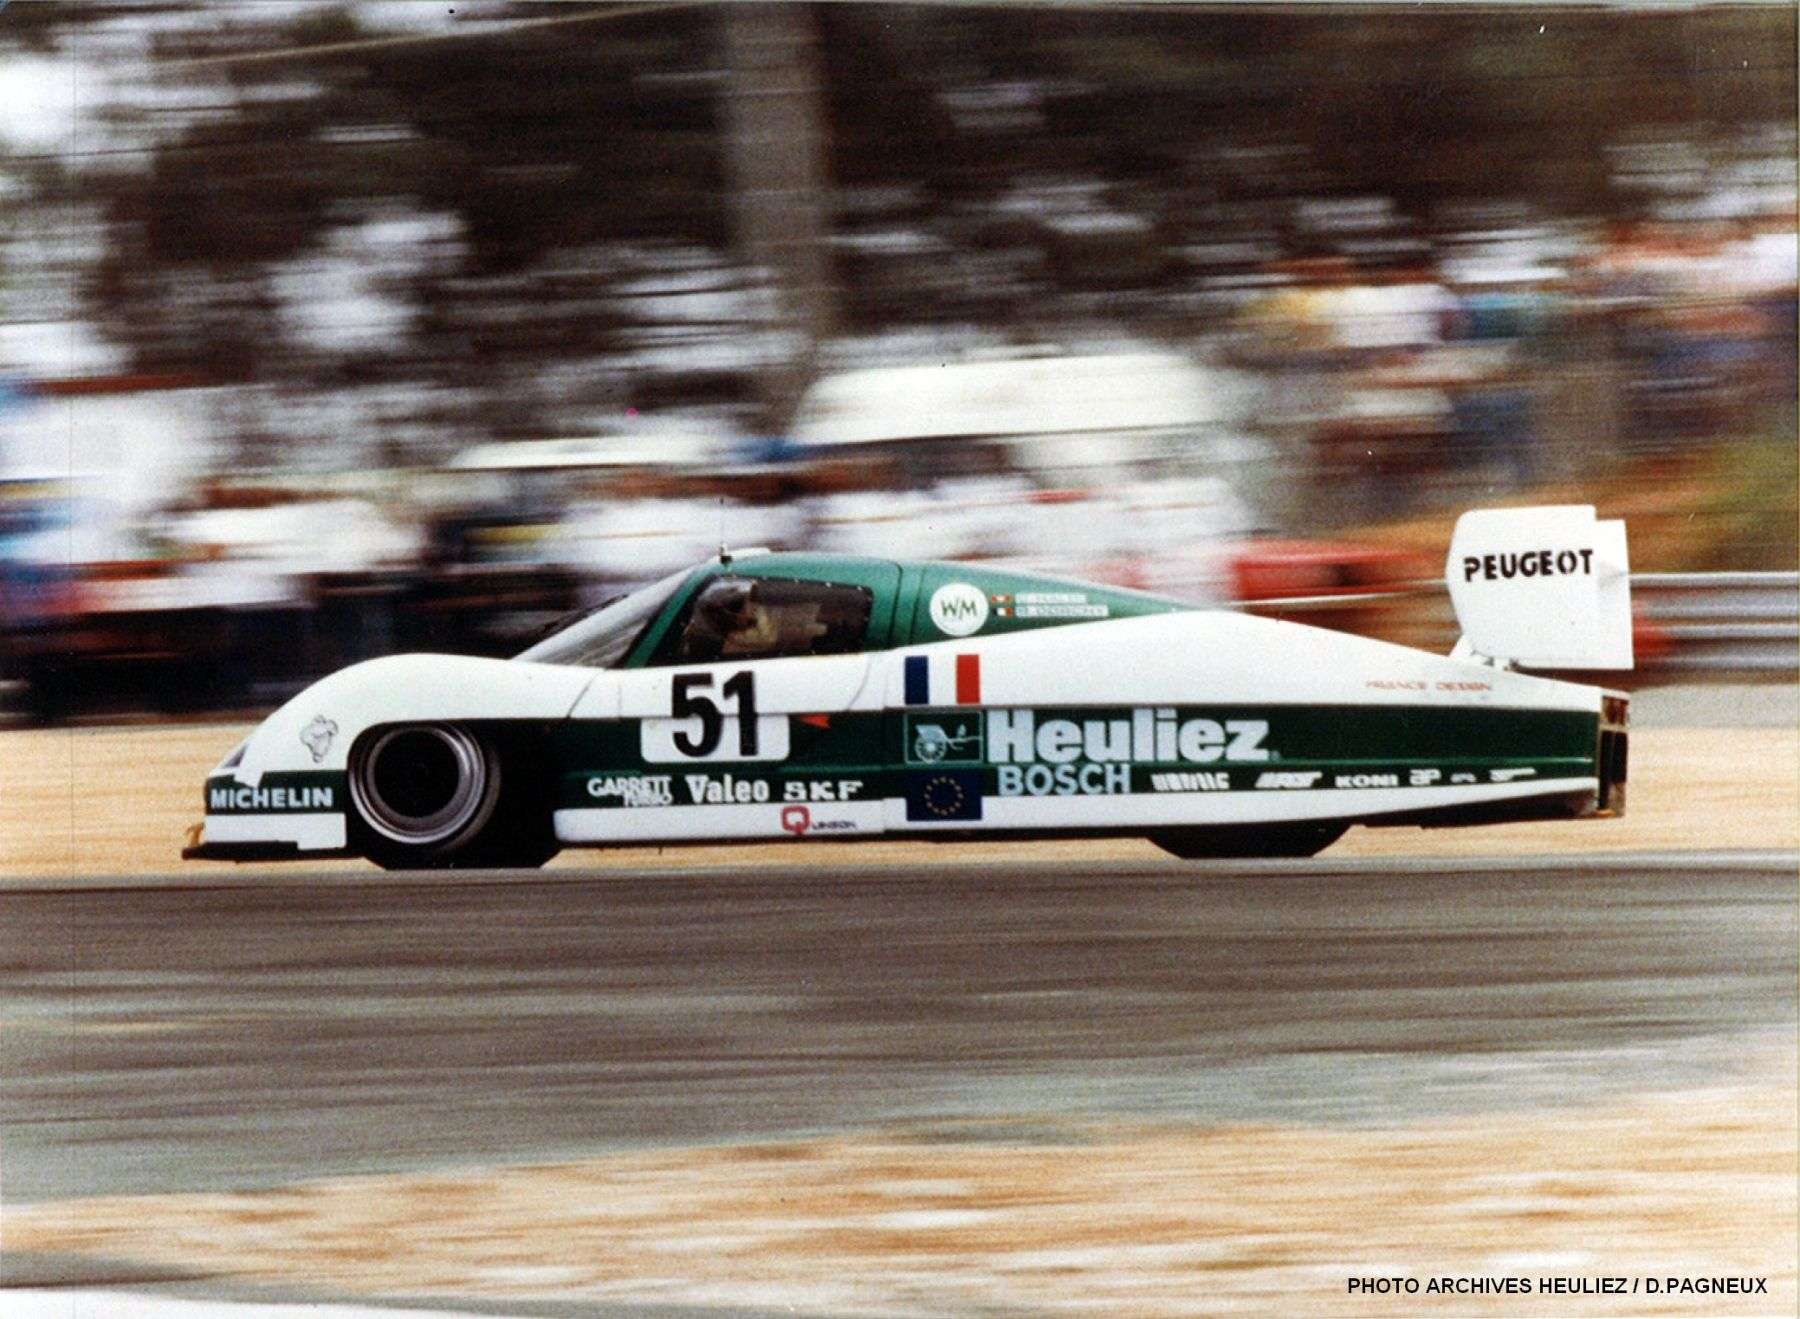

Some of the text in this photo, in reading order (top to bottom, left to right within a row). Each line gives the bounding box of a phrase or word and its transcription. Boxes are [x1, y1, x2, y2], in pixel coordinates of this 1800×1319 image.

[1464, 549, 1594, 582] PEUGEOT
[671, 670, 760, 758] 51
[987, 707, 1270, 763] Heuliez
[586, 775, 673, 798] GARRETT
[685, 774, 770, 803] Valeo
[783, 780, 865, 802] SKF
[997, 764, 1132, 796] BOSCH
[1334, 773, 1400, 788] KONI
[210, 786, 333, 809] MICHELIN
